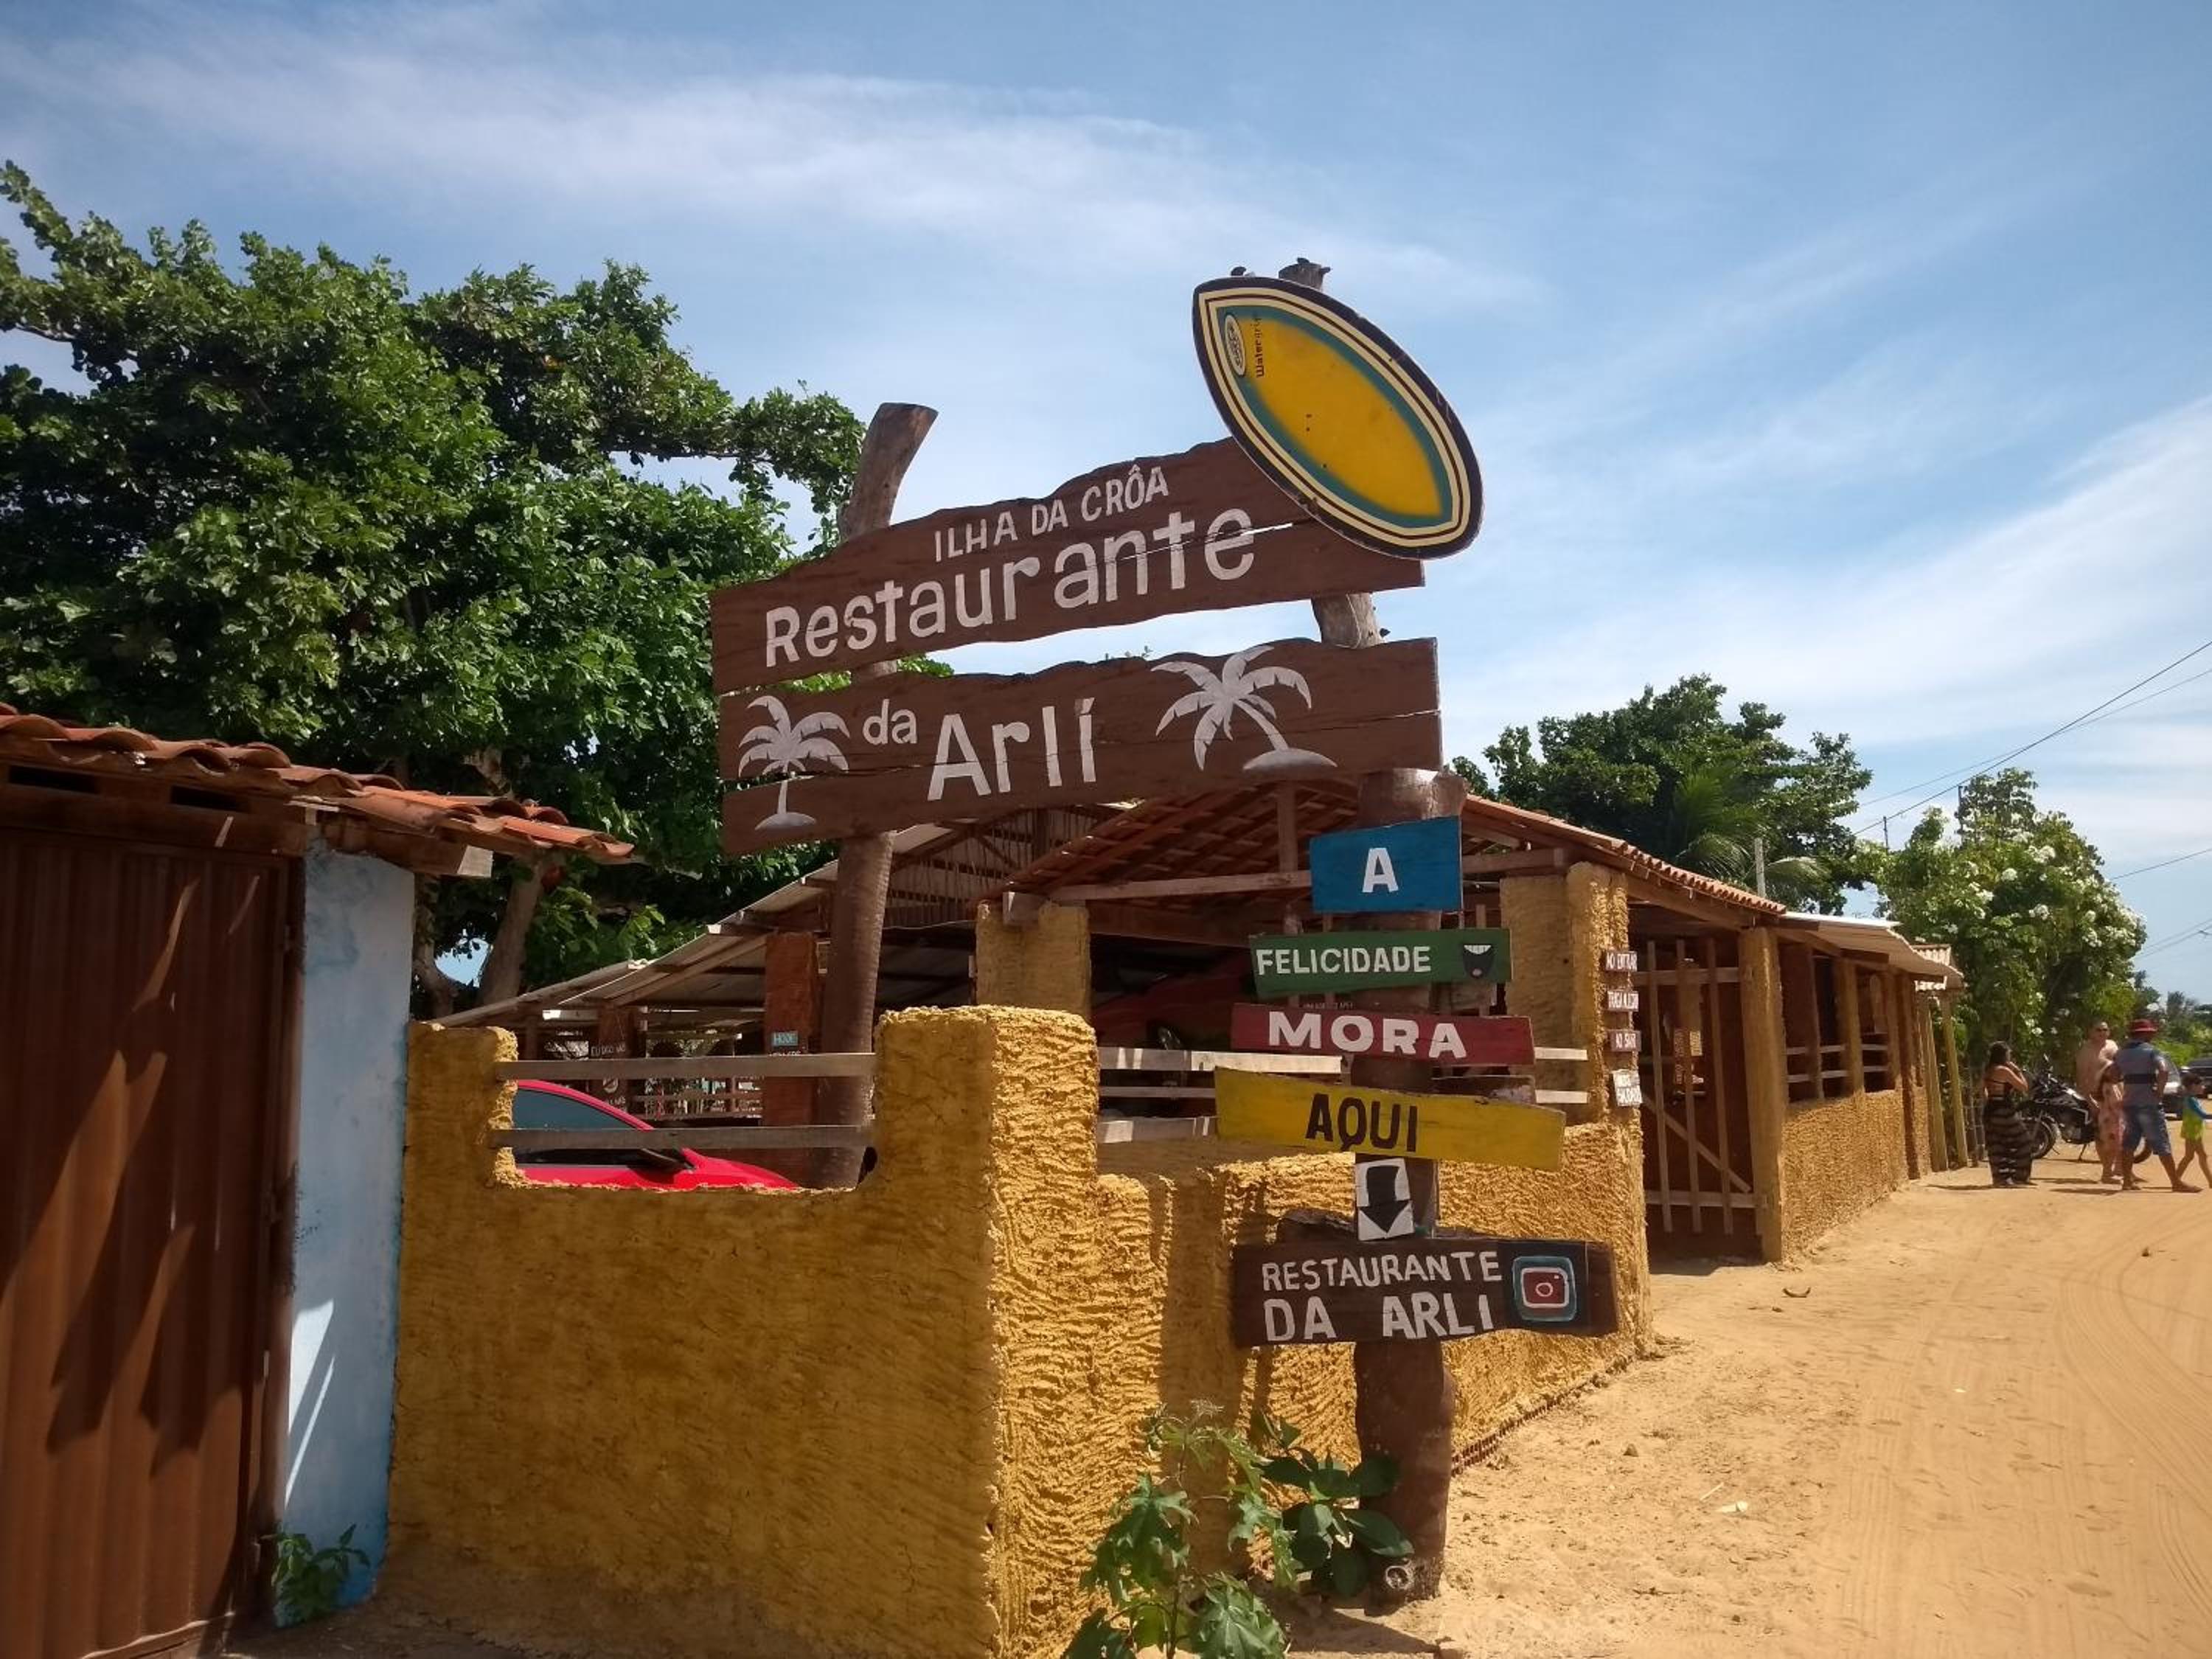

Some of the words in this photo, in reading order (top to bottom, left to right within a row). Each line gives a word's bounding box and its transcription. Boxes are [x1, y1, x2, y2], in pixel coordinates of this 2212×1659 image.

[935, 511, 1018, 562] ILHA
[1033, 499, 1068, 536] DA
[1081, 464, 1169, 522] CRÔA
[766, 508, 1254, 667] Restaurante
[862, 698, 917, 745] da
[1362, 847, 1399, 894] A
[1256, 946, 1431, 975] FELICIDADE
[1269, 1011, 1467, 1059] MORA
[1305, 1093, 1418, 1152] AQUI
[1262, 1251, 1502, 1290] RESTAURANTE
[1263, 1295, 1337, 1341] DA
[1382, 1292, 1494, 1339] ARLI
